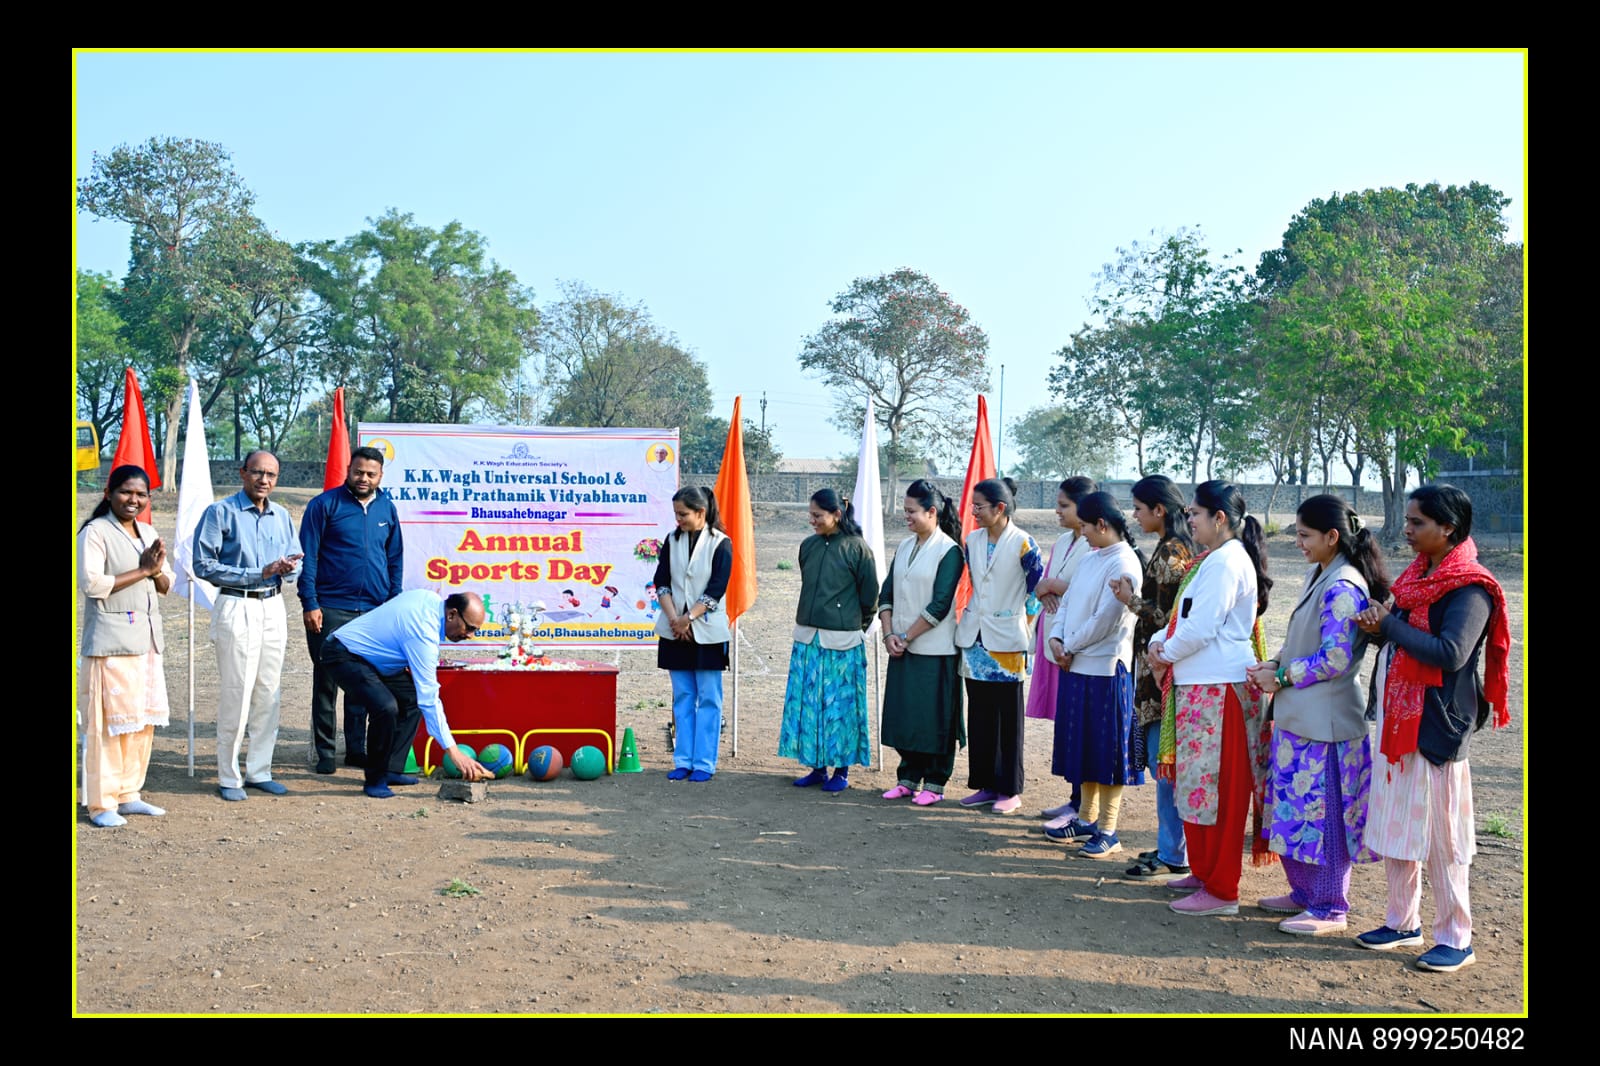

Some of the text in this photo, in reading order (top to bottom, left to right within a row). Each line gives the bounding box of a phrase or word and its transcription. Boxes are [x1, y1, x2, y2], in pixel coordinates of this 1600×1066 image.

[404, 469, 627, 486] K.K.Wagh Universal School &
[382, 487, 647, 505] K.K.Wagh Prathamik Vidyabhavan
[471, 507, 567, 521] Bhausahebnagar
[457, 529, 583, 551] Annual
[426, 558, 612, 585] Sports Day
[474, 627, 505, 638] ersal
